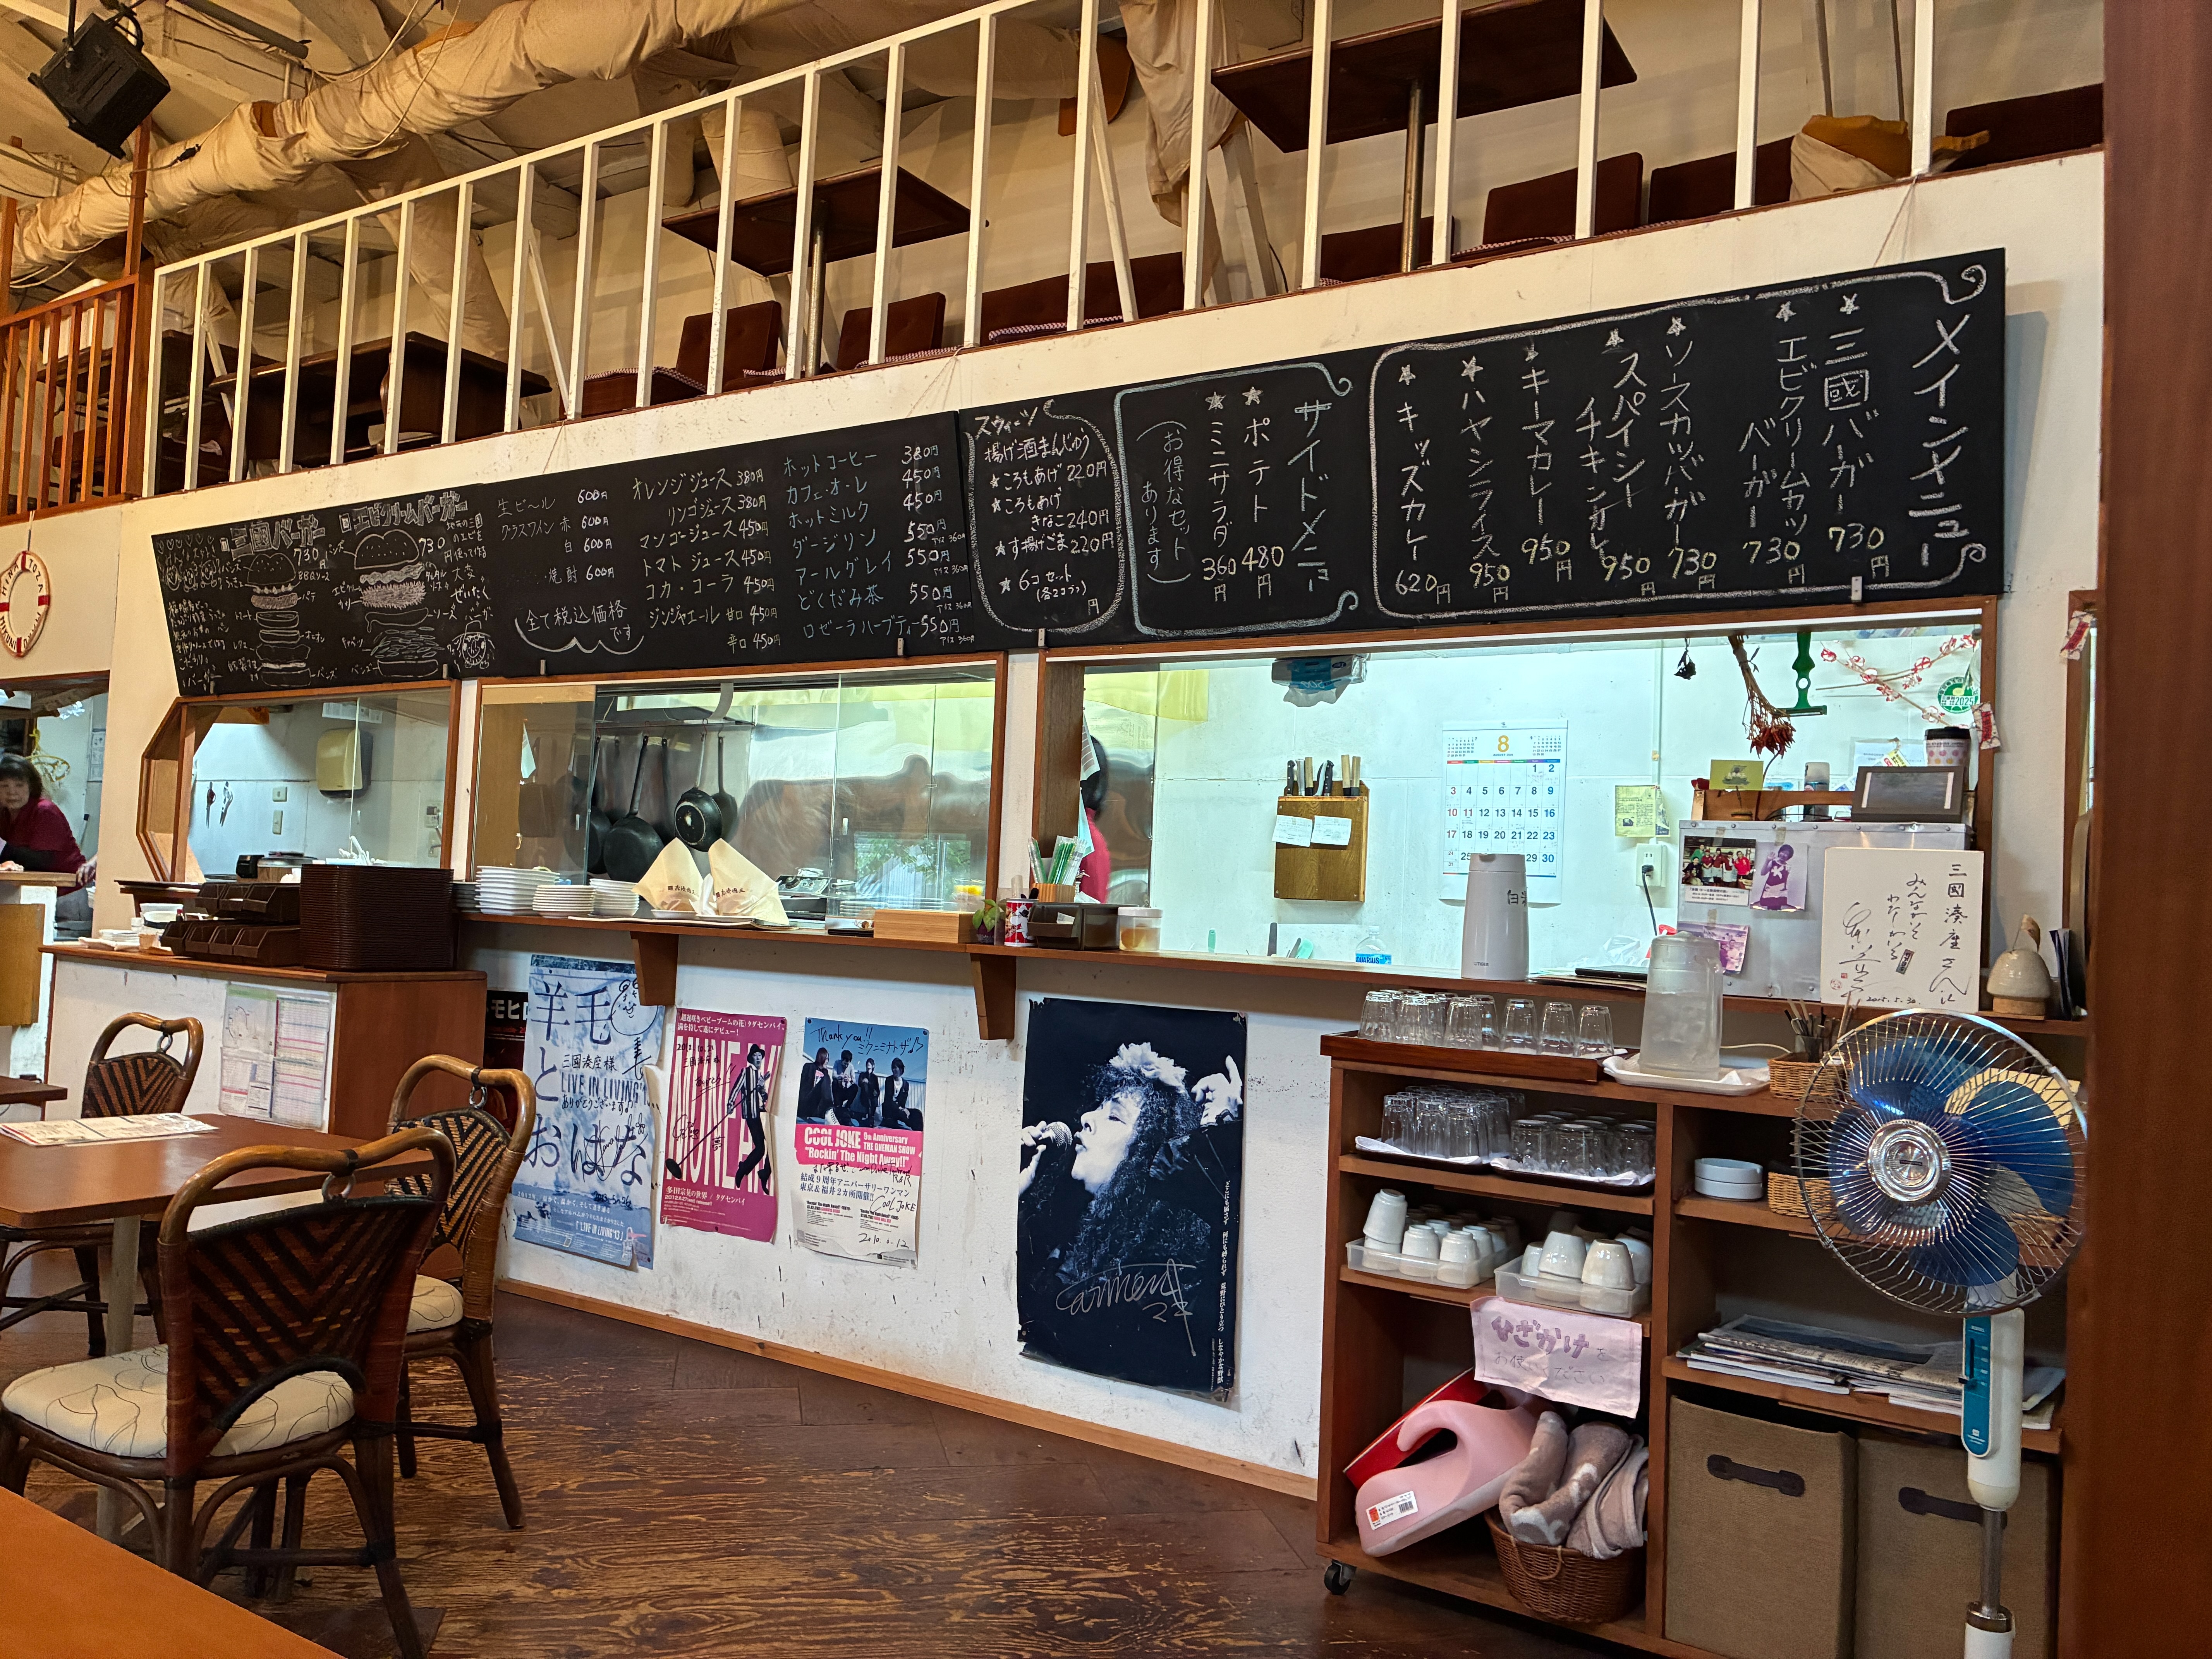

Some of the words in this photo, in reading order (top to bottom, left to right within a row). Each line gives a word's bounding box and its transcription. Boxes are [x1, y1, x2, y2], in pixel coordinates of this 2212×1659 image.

[1244, 417, 1271, 522] ポテト
[1208, 422, 1232, 548] ミニサラダ
[564, 539, 572, 553] 白
[610, 624, 630, 642] です
[1497, 735, 1509, 752] 8
[1450, 787, 1456, 795] 3
[1466, 787, 1472, 795] 4
[1482, 787, 1488, 795] 5
[1498, 787, 1504, 795] 6
[1515, 787, 1521, 795] 7
[1531, 787, 1537, 795] 8
[1547, 787, 1554, 795] 9
[1448, 809, 1458, 817] 10
[1463, 809, 1473, 817] 11
[1479, 809, 1490, 817] 12
[1495, 809, 1506, 817] 13
[1511, 809, 1522, 817] 14
[1528, 809, 1539, 817] 15
[1544, 809, 1555, 817] 16
[1446, 830, 1457, 838] 17
[1462, 831, 1473, 839] 18
[1478, 831, 1489, 839] 19
[1494, 831, 1506, 839] 20
[1511, 831, 1522, 840] 21
[1527, 832, 1538, 840] 22
[1543, 832, 1555, 840] 23
[1526, 854, 1537, 862] 29
[1542, 854, 1554, 862] 30
[562, 1072, 584, 1095] LIVE
[589, 1075, 599, 1097] IN
[804, 1127, 833, 1147] COOL
[835, 1130, 861, 1149] JOKE
[873, 1133, 908, 1145] Anniversary
[864, 1142, 874, 1150] THE
[874, 1143, 898, 1153] ONEMAN
[898, 1146, 916, 1155] SHOW
[840, 1150, 855, 1162] The
[857, 1152, 878, 1165] Night
